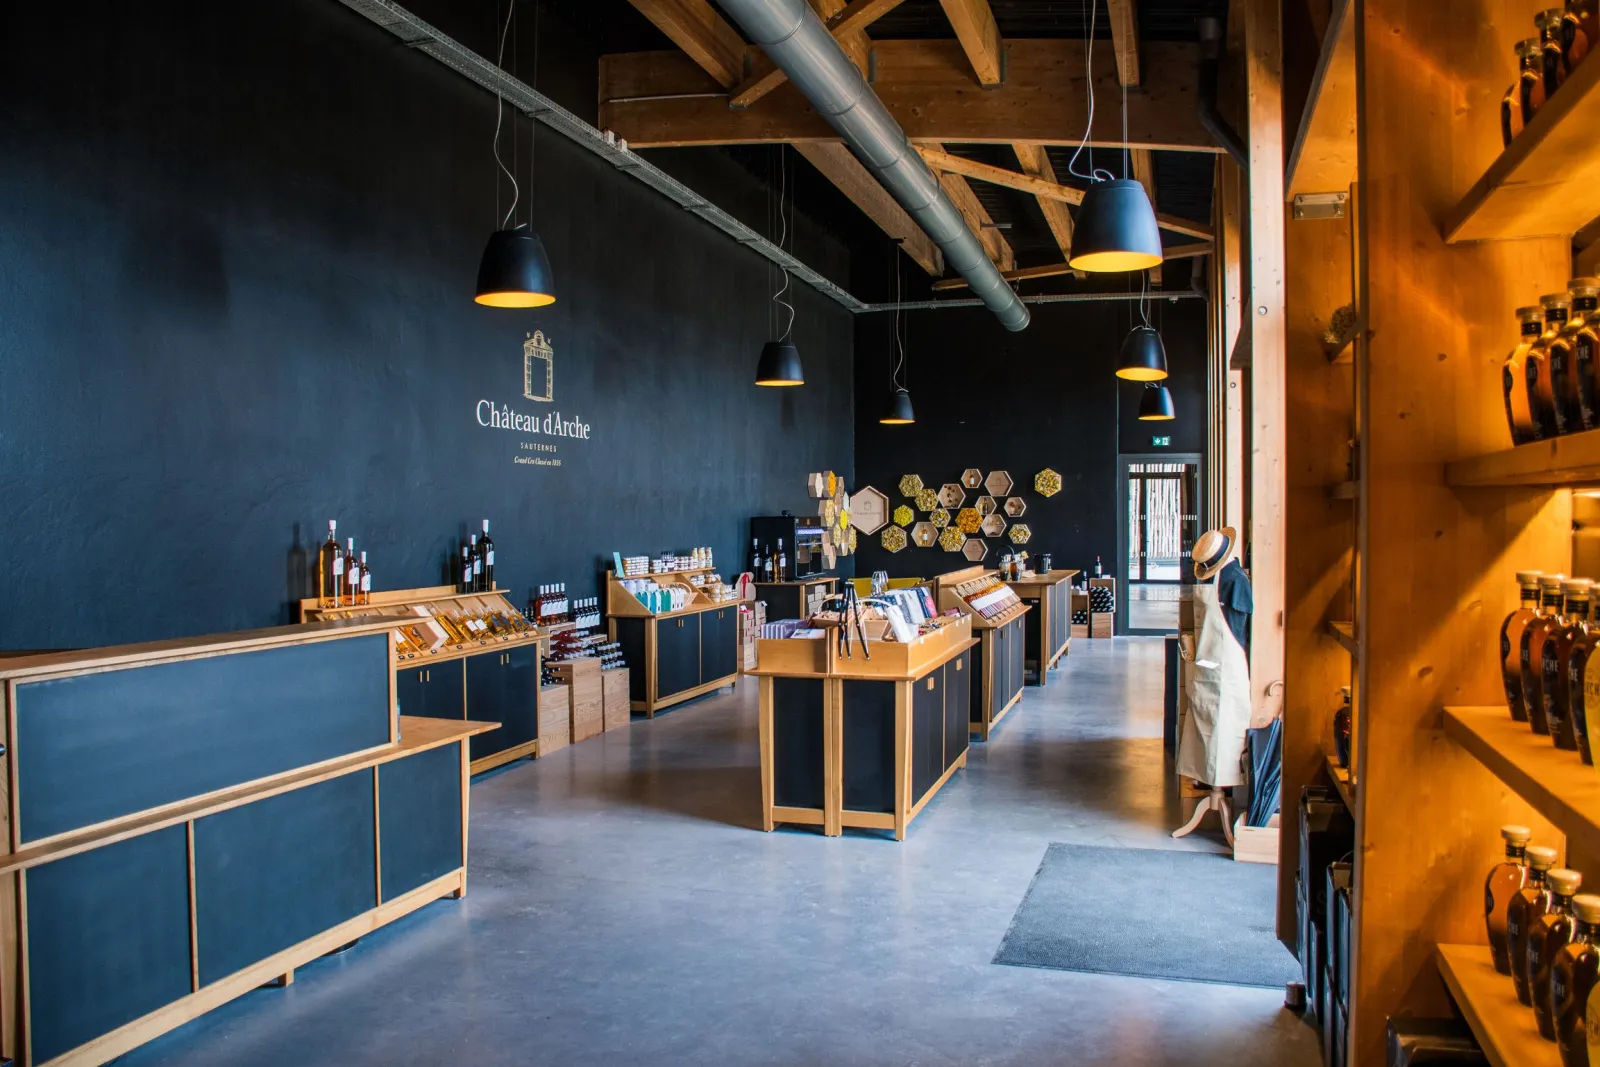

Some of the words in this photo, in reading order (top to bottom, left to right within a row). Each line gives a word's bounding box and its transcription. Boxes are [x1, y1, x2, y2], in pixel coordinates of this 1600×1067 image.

[476, 400, 540, 433] Château
[543, 411, 590, 439] d'Arche
[520, 442, 557, 453] SAUTERNES
[514, 455, 527, 465] Grand
[527, 457, 535, 465] Cru
